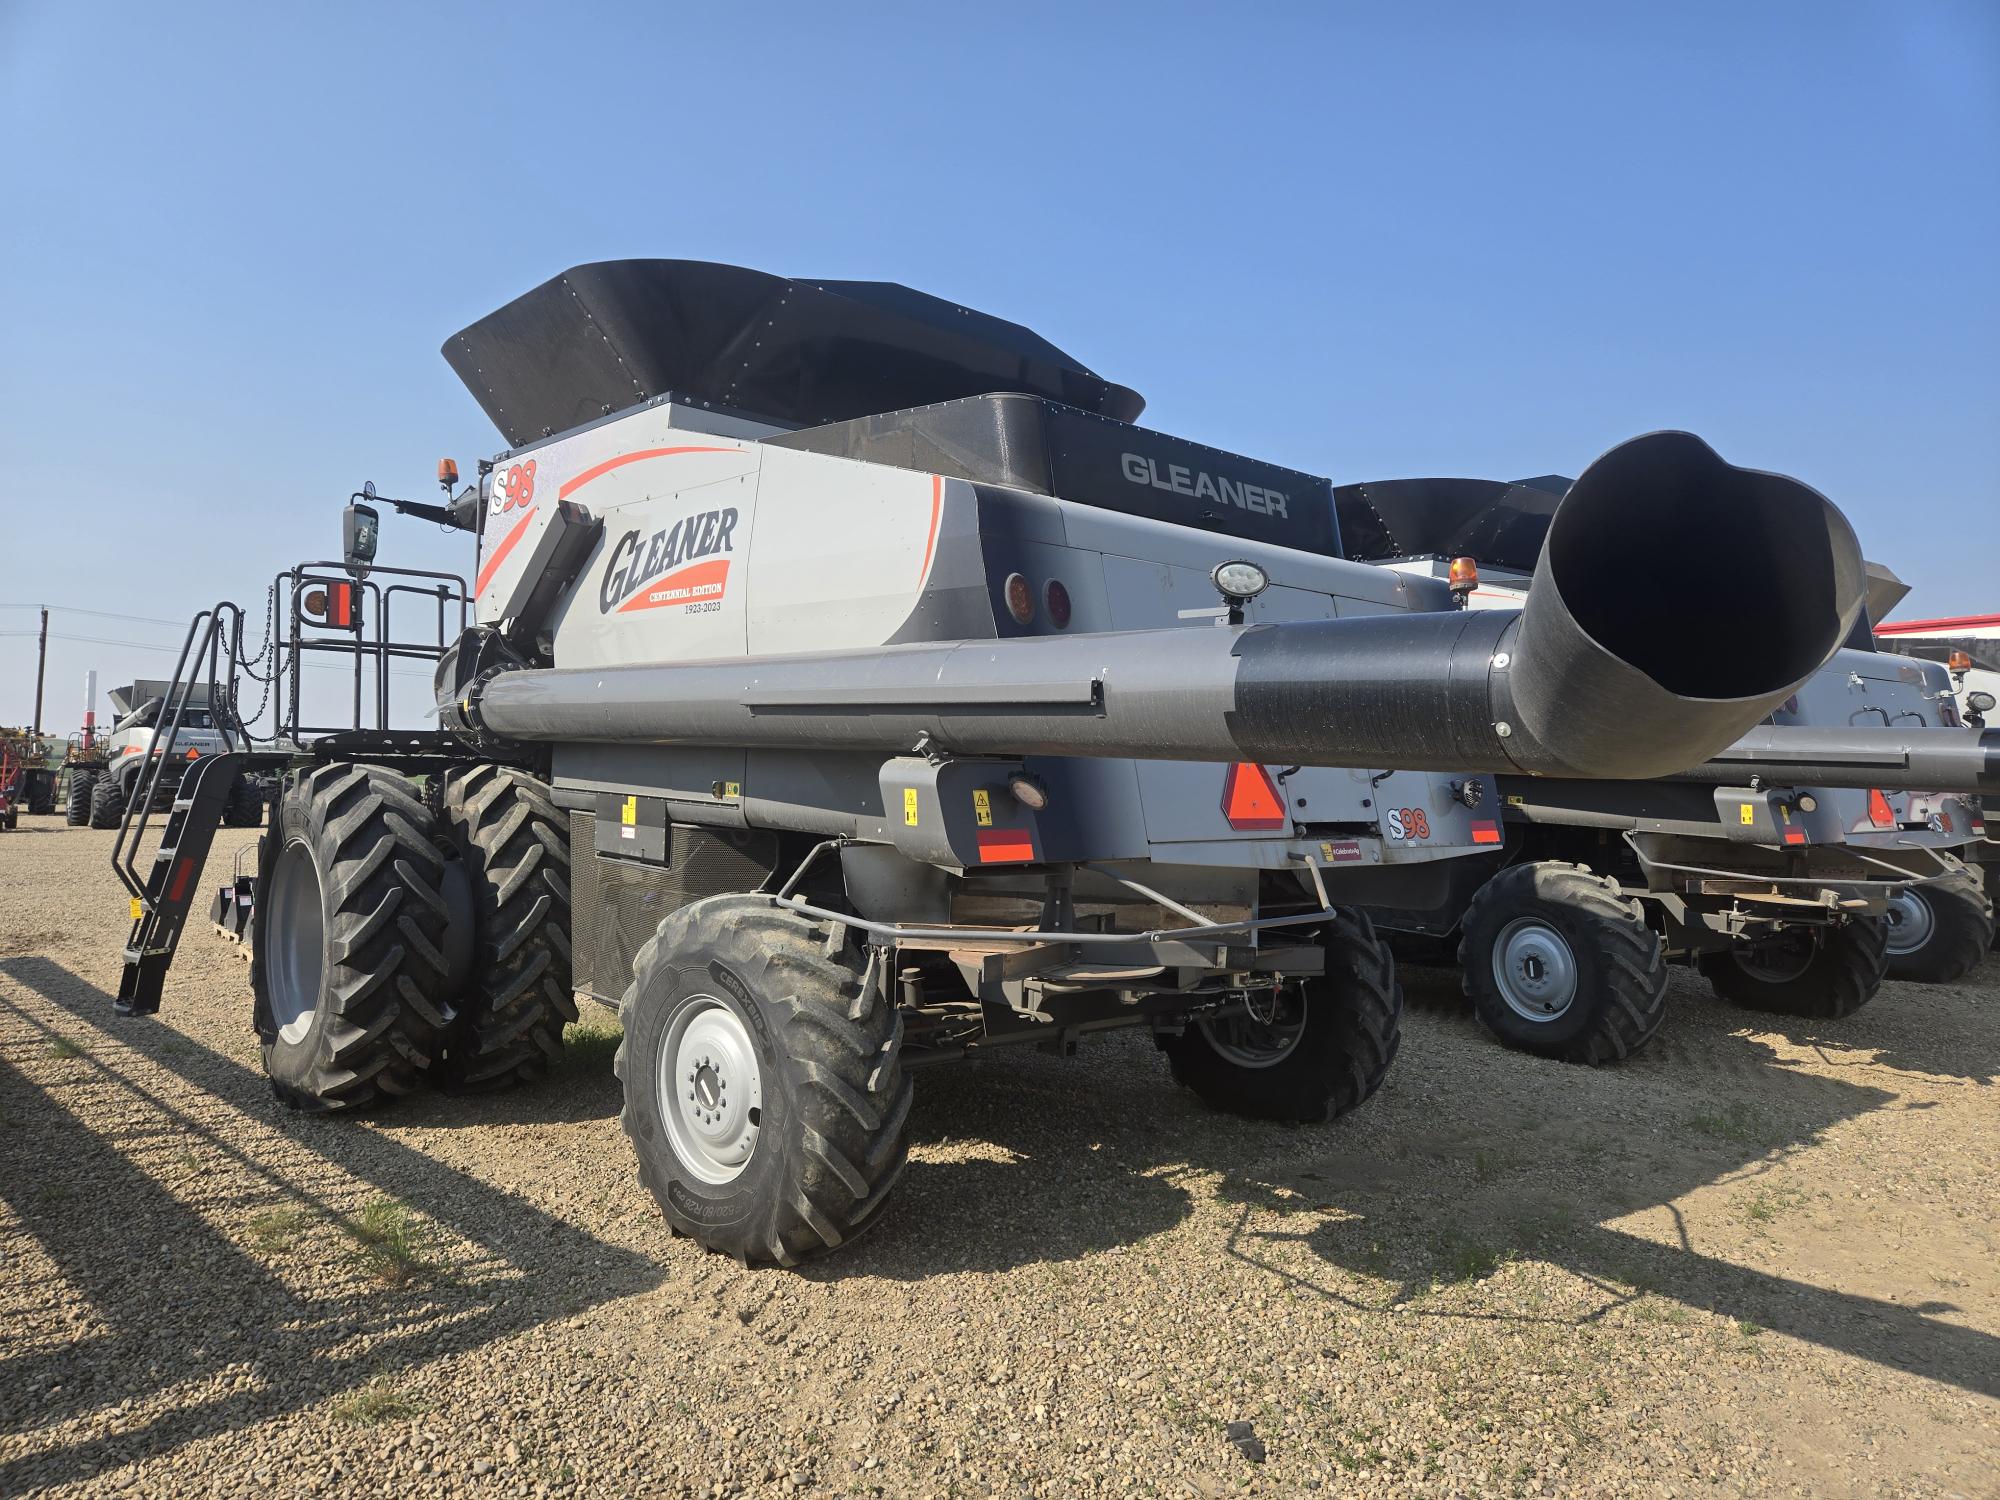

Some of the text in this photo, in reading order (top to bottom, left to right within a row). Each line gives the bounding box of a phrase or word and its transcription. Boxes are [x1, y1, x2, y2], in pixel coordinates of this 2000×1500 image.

[489, 458, 537, 517] S98
[1121, 452, 1289, 520] GLEANER
[599, 506, 739, 616] GLEANER
[649, 582, 723, 603] CENTENNIAL EDITION
[685, 601, 722, 615] 1923-2023
[1387, 807, 1431, 841] S98
